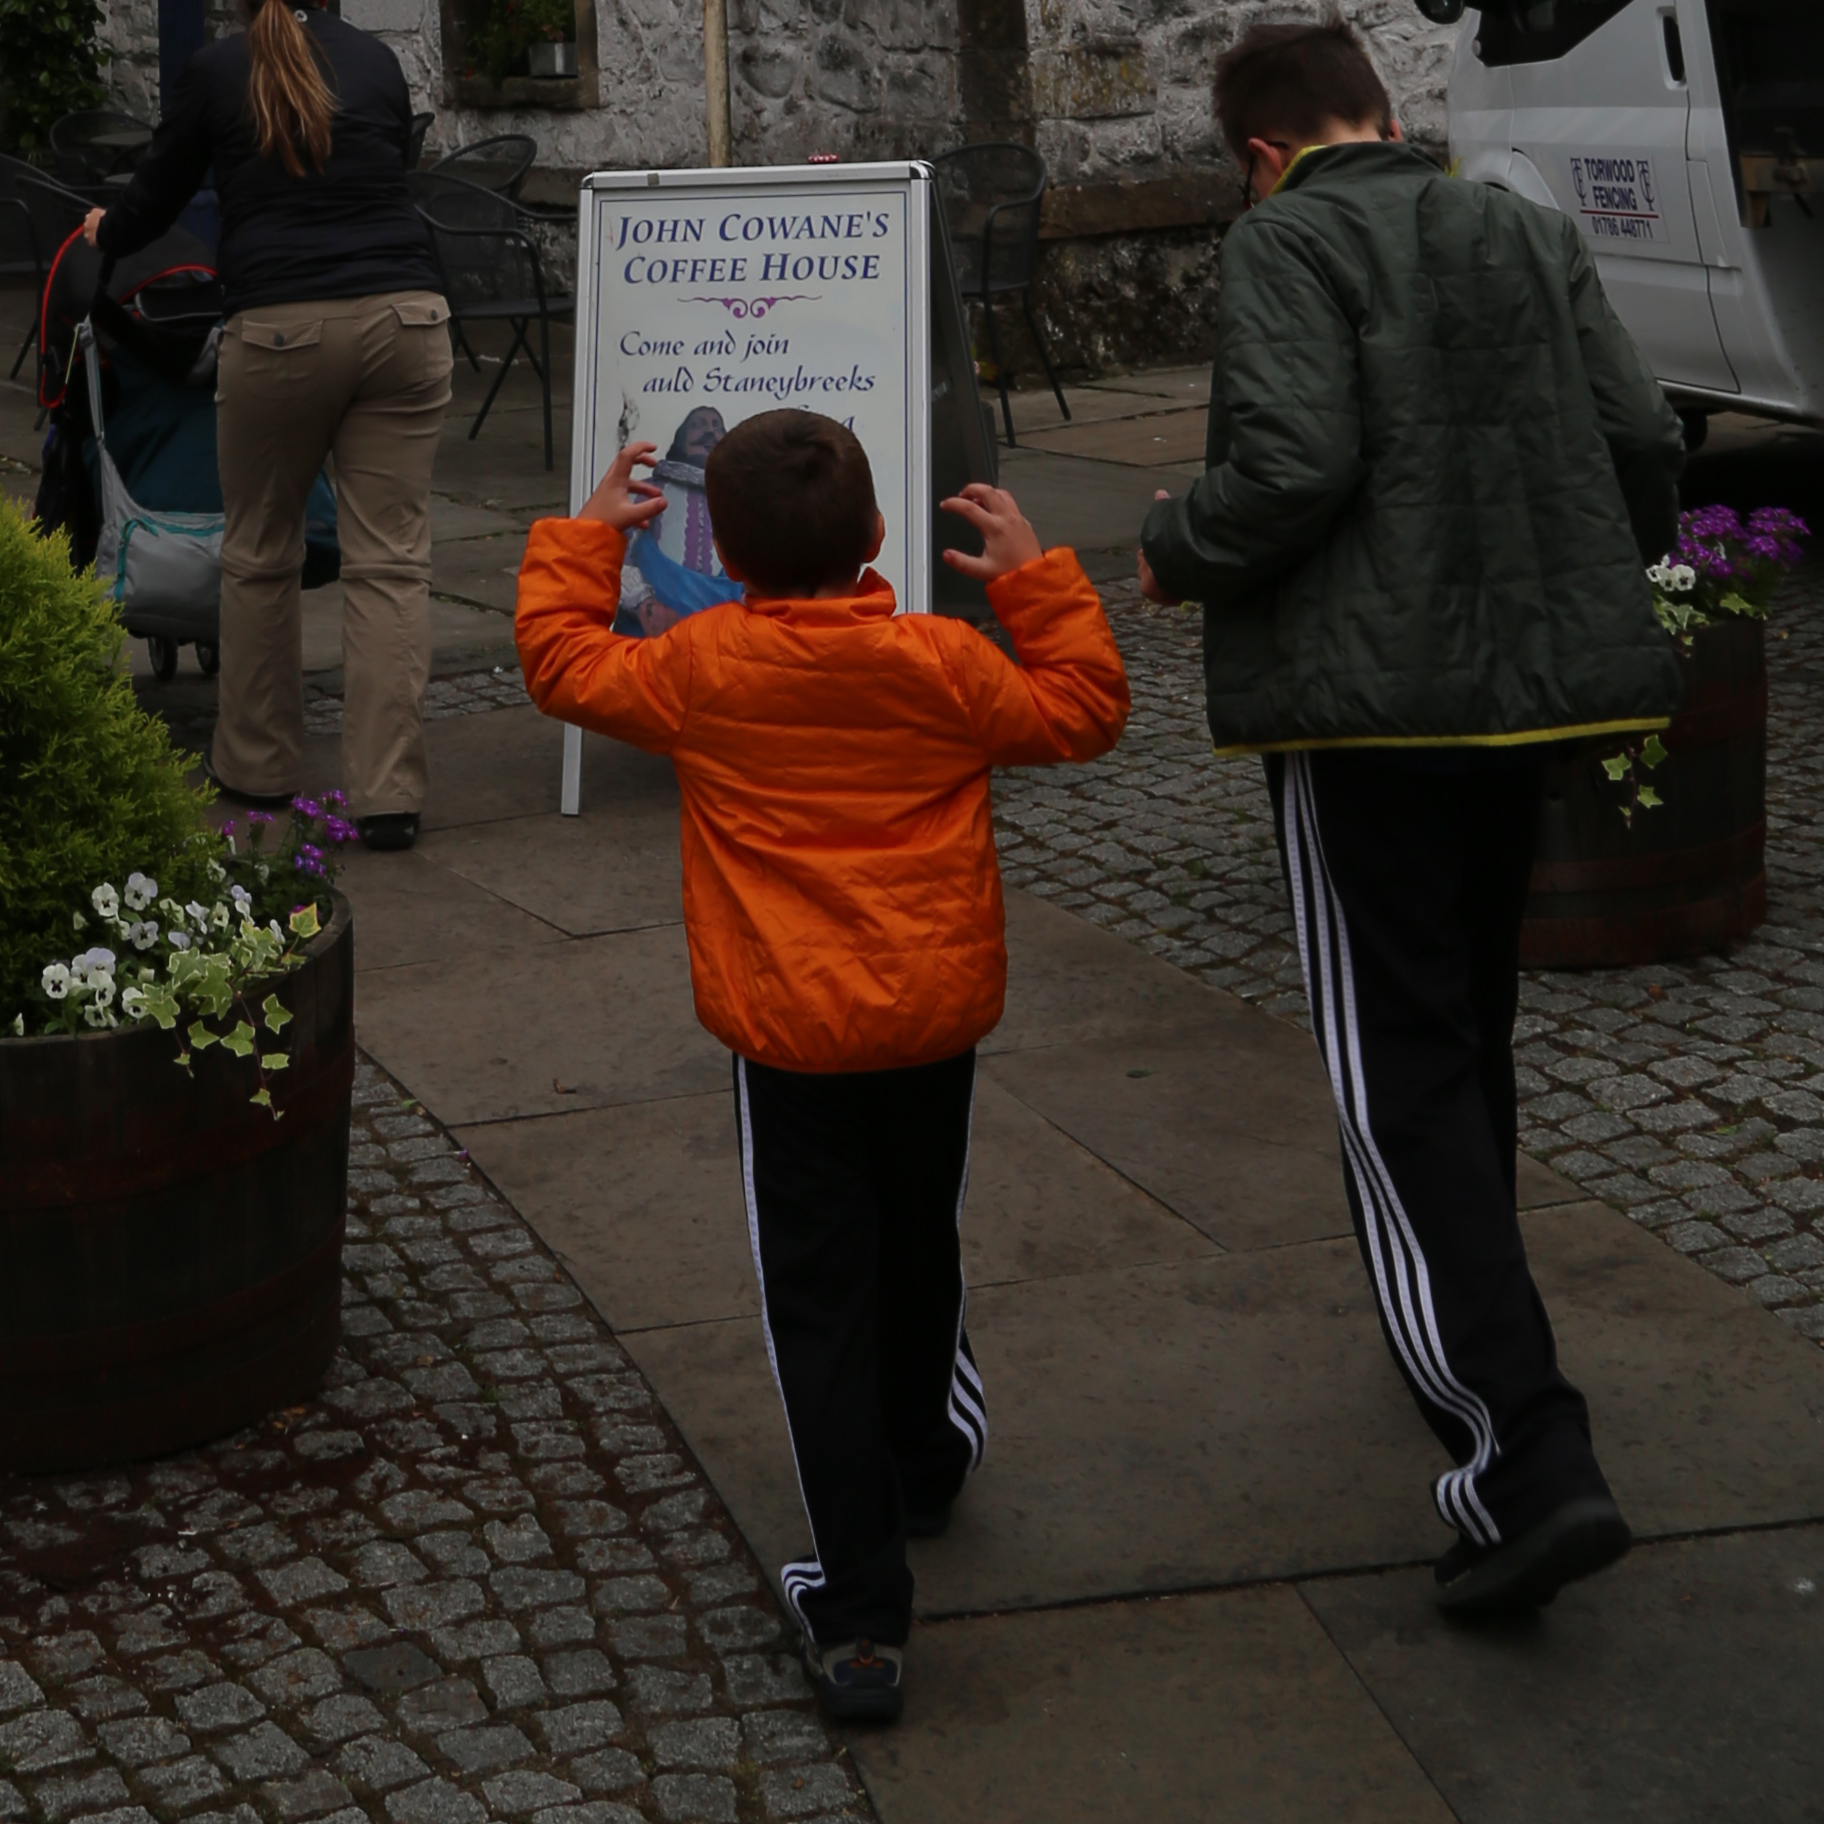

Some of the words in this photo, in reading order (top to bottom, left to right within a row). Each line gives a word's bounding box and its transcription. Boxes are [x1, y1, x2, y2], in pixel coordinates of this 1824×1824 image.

[1584, 158, 1635, 183] TORWOOD
[1592, 185, 1638, 211] FENCING
[615, 216, 706, 251] JOHN
[719, 211, 890, 241] COWANE'S
[1591, 216, 1620, 236] 01786
[1620, 217, 1654, 239] 448771
[623, 255, 748, 284] COFFEE
[759, 253, 881, 282] HOUSE
[620, 330, 685, 356] Come
[693, 329, 737, 356] and
[739, 333, 790, 363] join
[642, 366, 694, 393] auld
[702, 364, 876, 400] Staneybreeks
